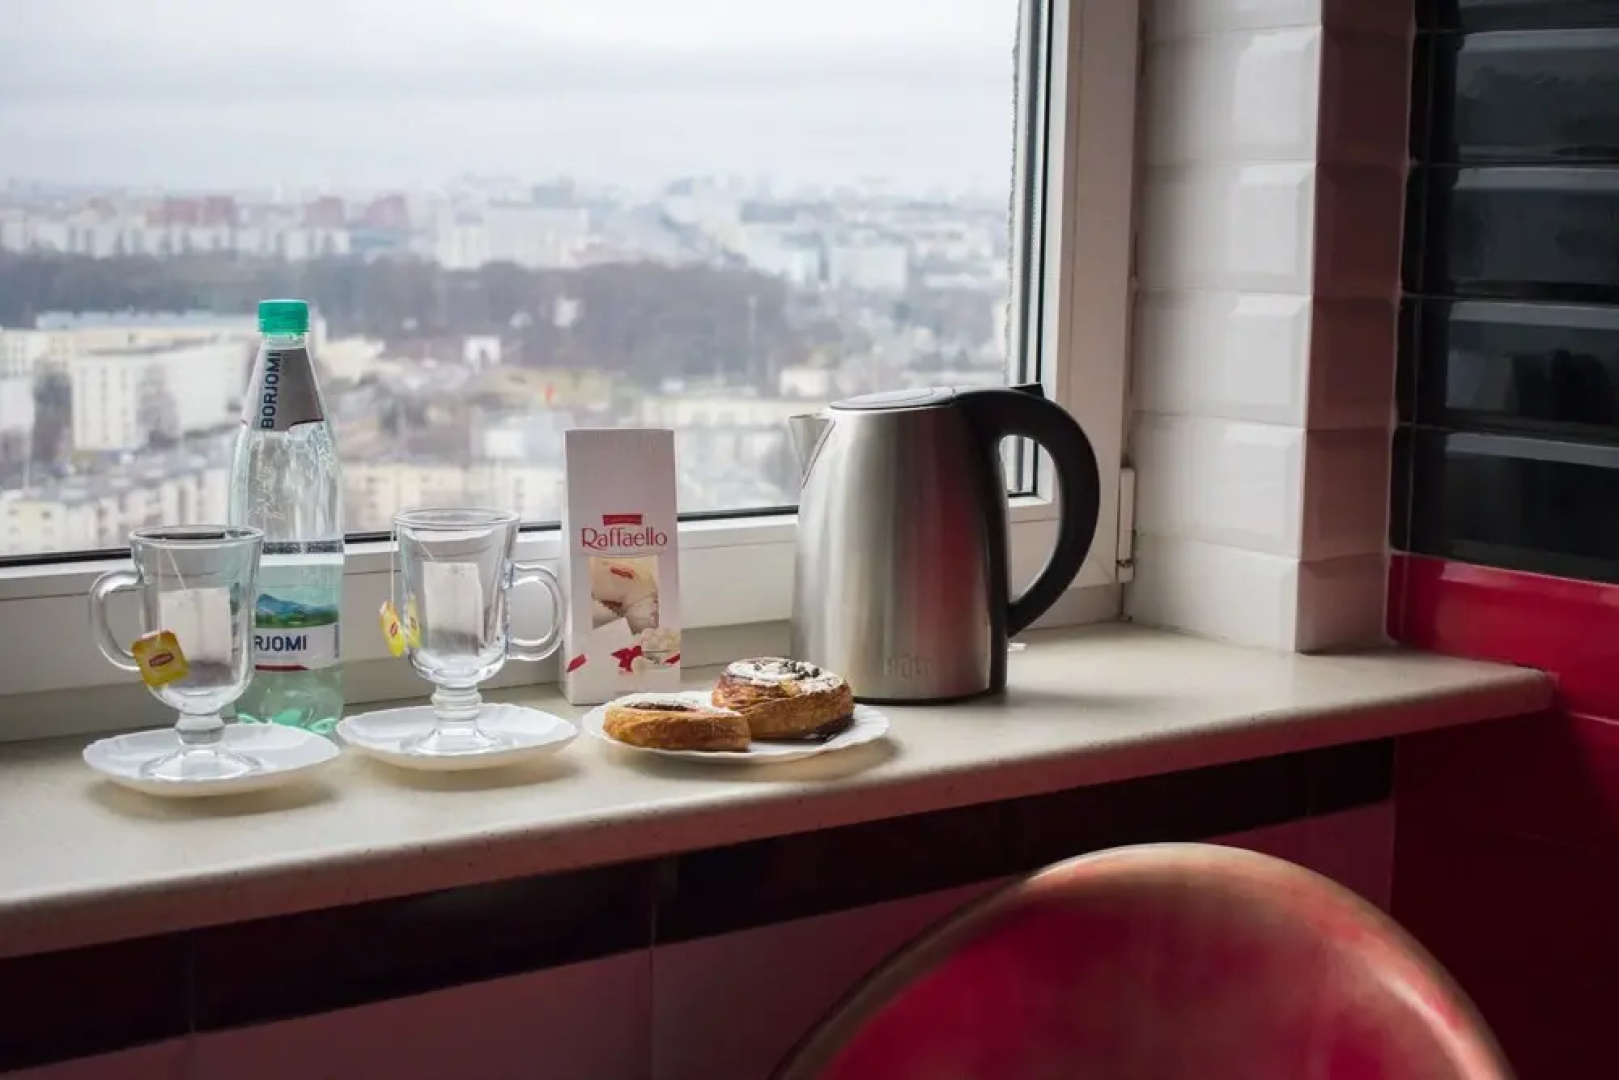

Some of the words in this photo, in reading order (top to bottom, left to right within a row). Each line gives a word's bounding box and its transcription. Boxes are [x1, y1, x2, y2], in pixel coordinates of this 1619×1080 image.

[261, 352, 281, 429] BORJOMI
[581, 526, 668, 549] Raffaello
[254, 635, 307, 651] RJOMI
